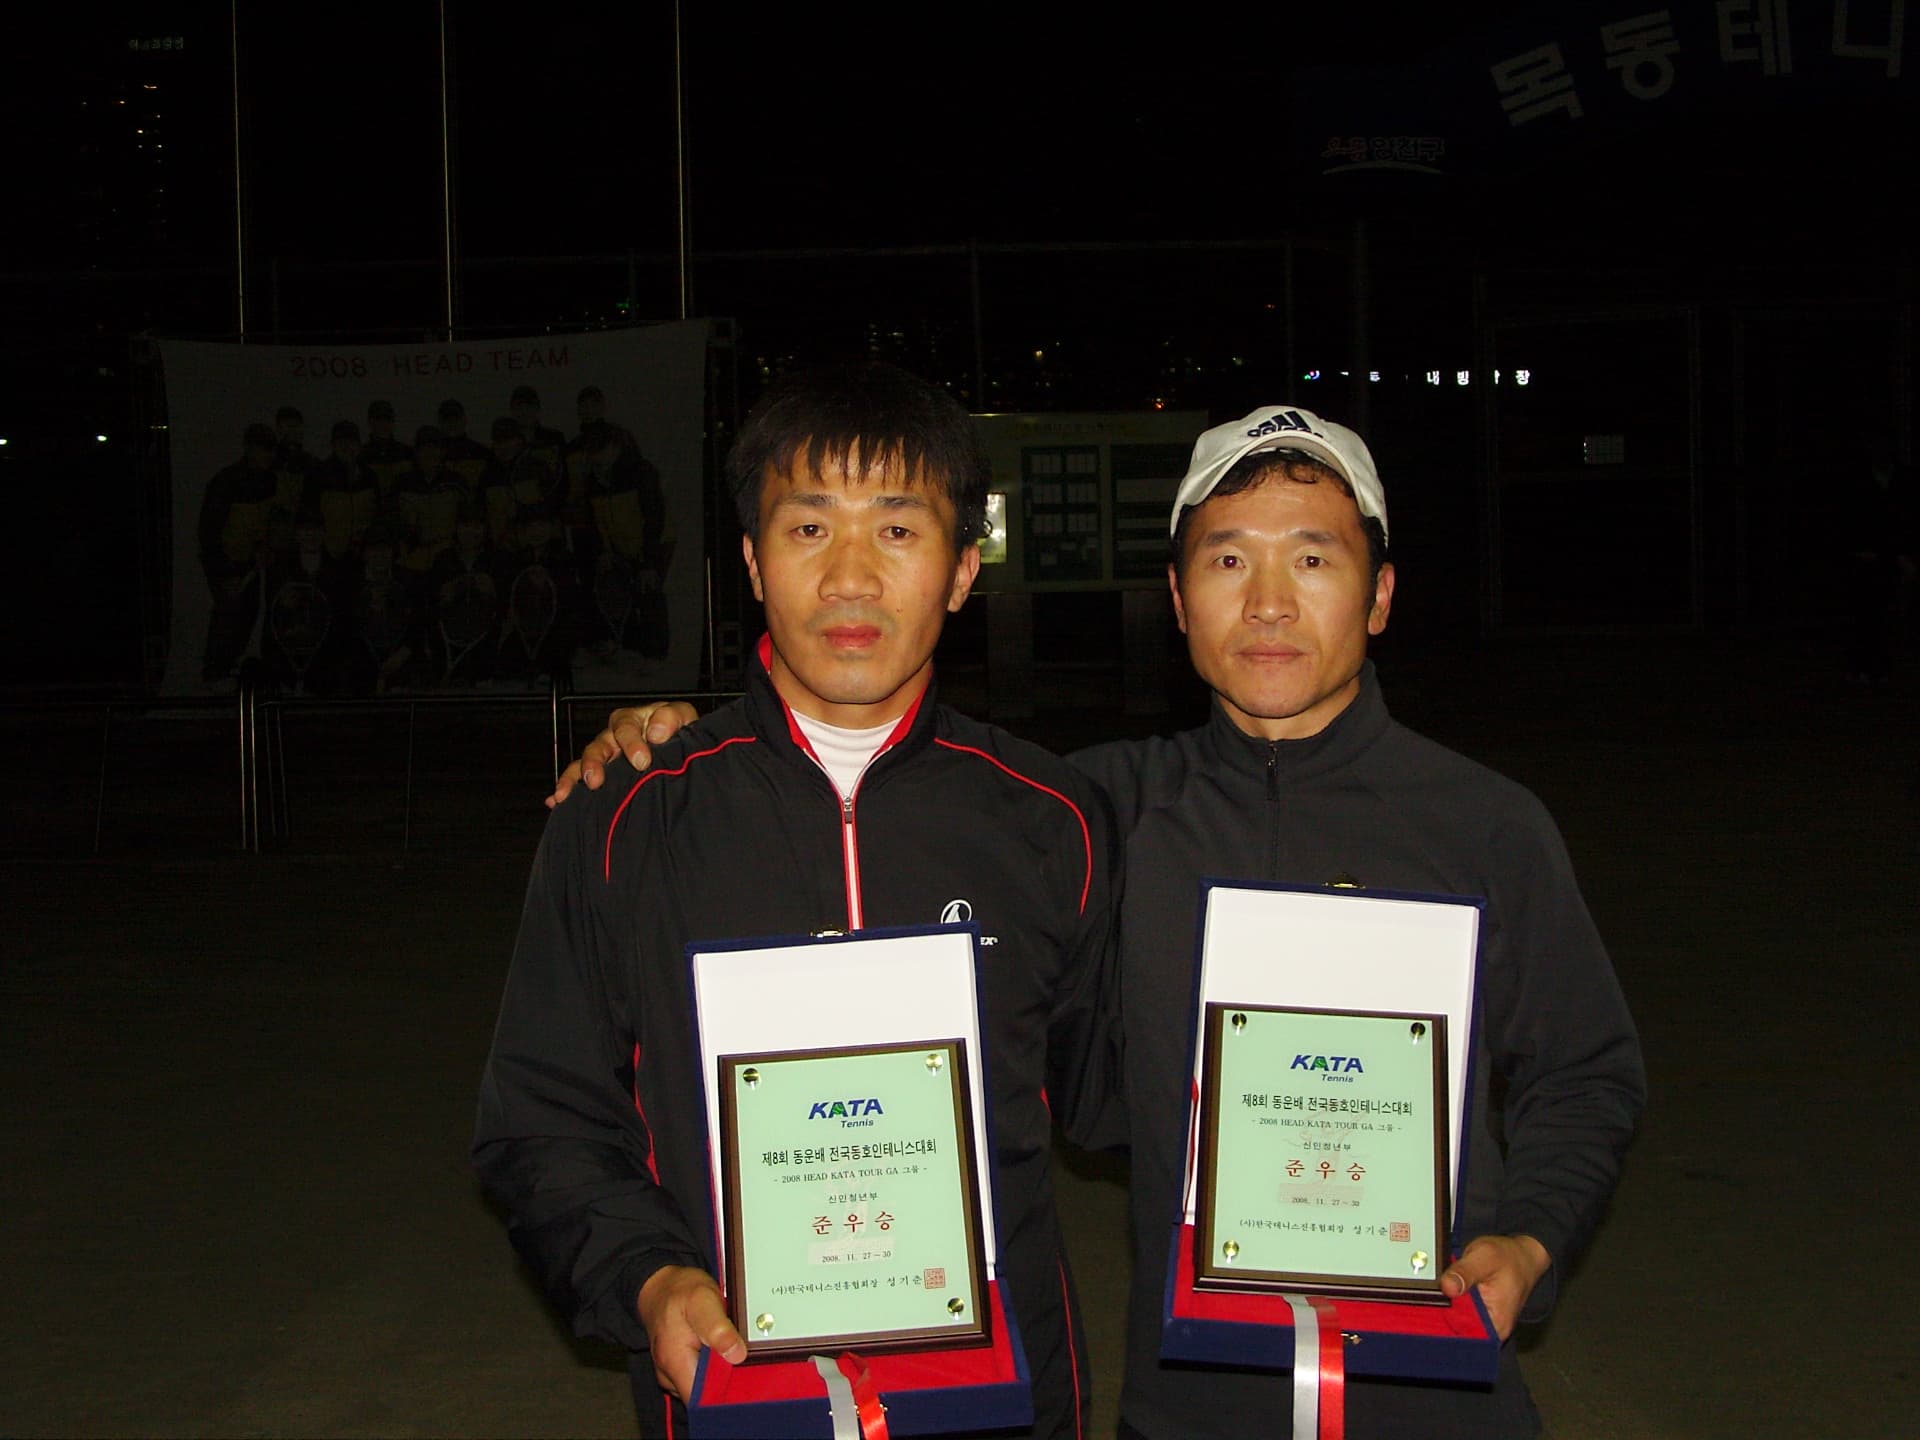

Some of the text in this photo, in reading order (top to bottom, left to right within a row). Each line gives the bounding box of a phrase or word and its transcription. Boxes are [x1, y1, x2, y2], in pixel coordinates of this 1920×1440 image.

[292, 346, 569, 377] 2008 HEAD TEAM
[1290, 1054, 1364, 1073] KATA
[1321, 1073, 1354, 1083] Tennis
[808, 1098, 884, 1120] KATA
[1242, 1094, 1412, 1116] 제8회 동운배 전국동호인테니스대회
[840, 1118, 874, 1129] Tennis
[1281, 1119, 1304, 1127] HEAD
[1334, 1122, 1358, 1130] TOUR
[762, 1139, 937, 1166] 제8회 동운배 전국동호인테니스대회
[782, 1175, 800, 1183] 2008
[804, 1173, 828, 1182] HEAD
[831, 1171, 855, 1179] KATA
[858, 1168, 883, 1177] TOUR
[829, 1192, 878, 1204] 신인청년부
